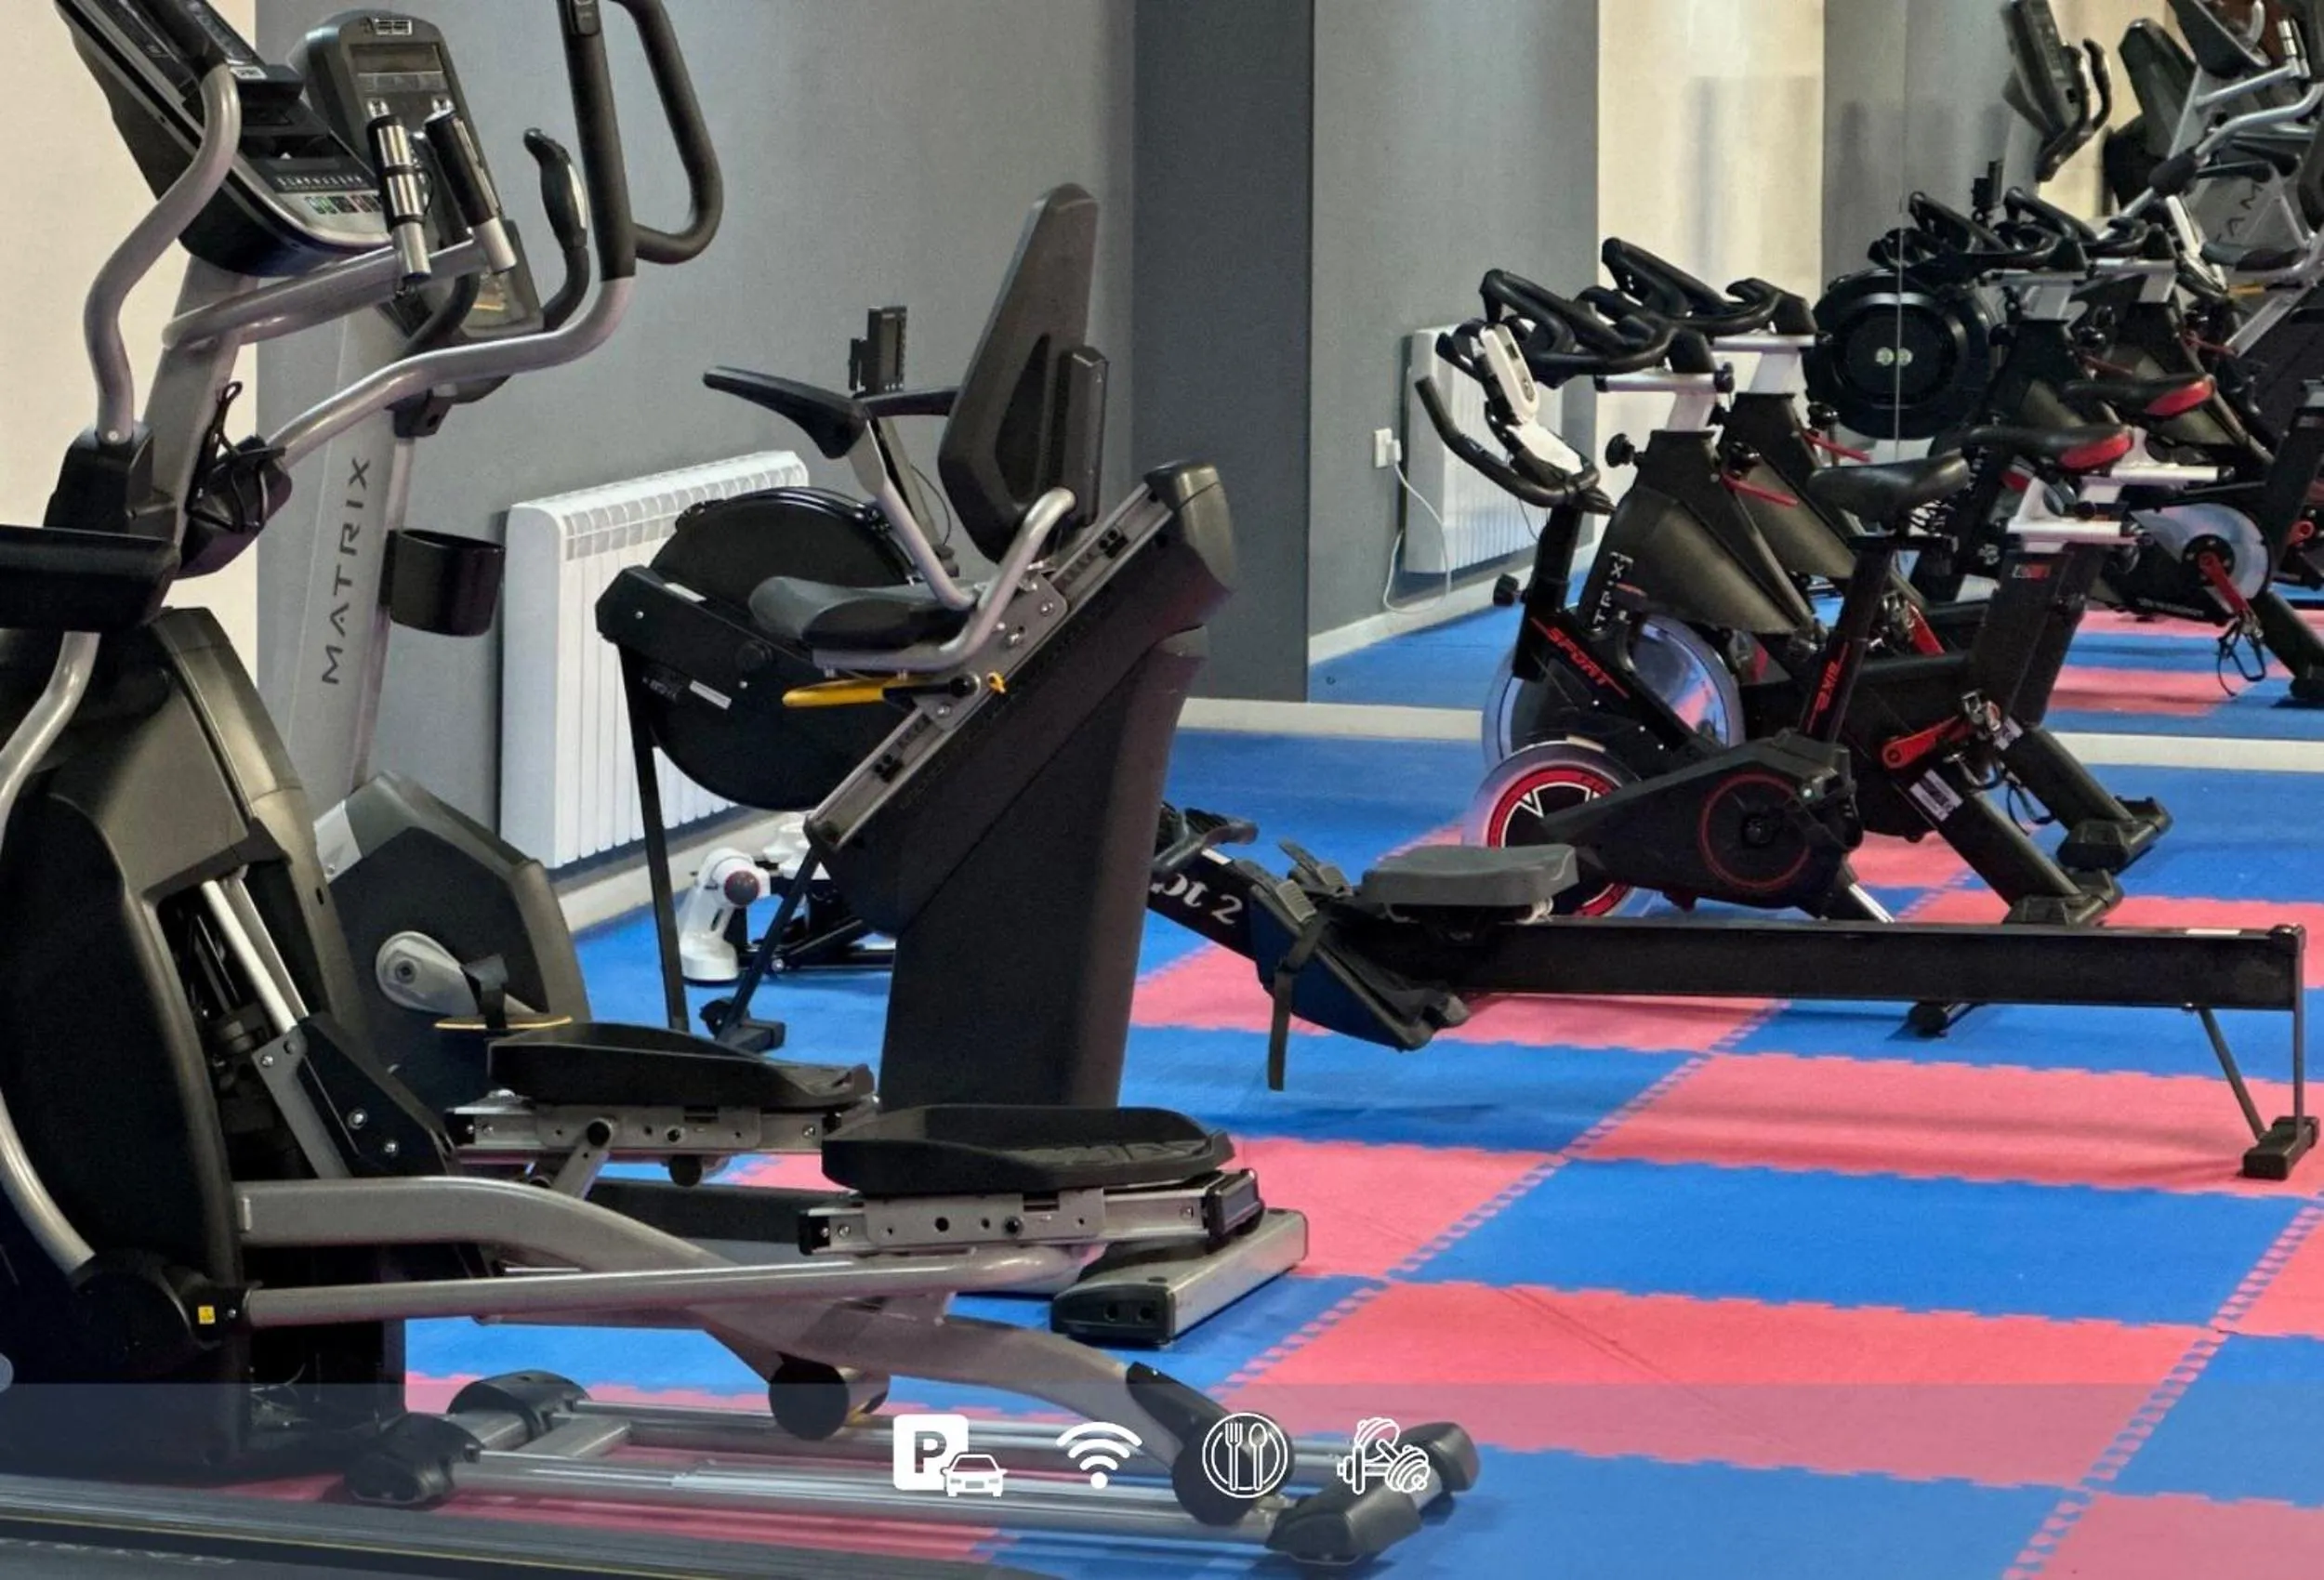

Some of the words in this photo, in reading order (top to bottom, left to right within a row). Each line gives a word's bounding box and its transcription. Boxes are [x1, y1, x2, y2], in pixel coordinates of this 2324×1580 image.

[322, 457, 371, 685] MATRIX
[1545, 626, 1608, 686] SPORT
[1210, 894, 1243, 925] 2
